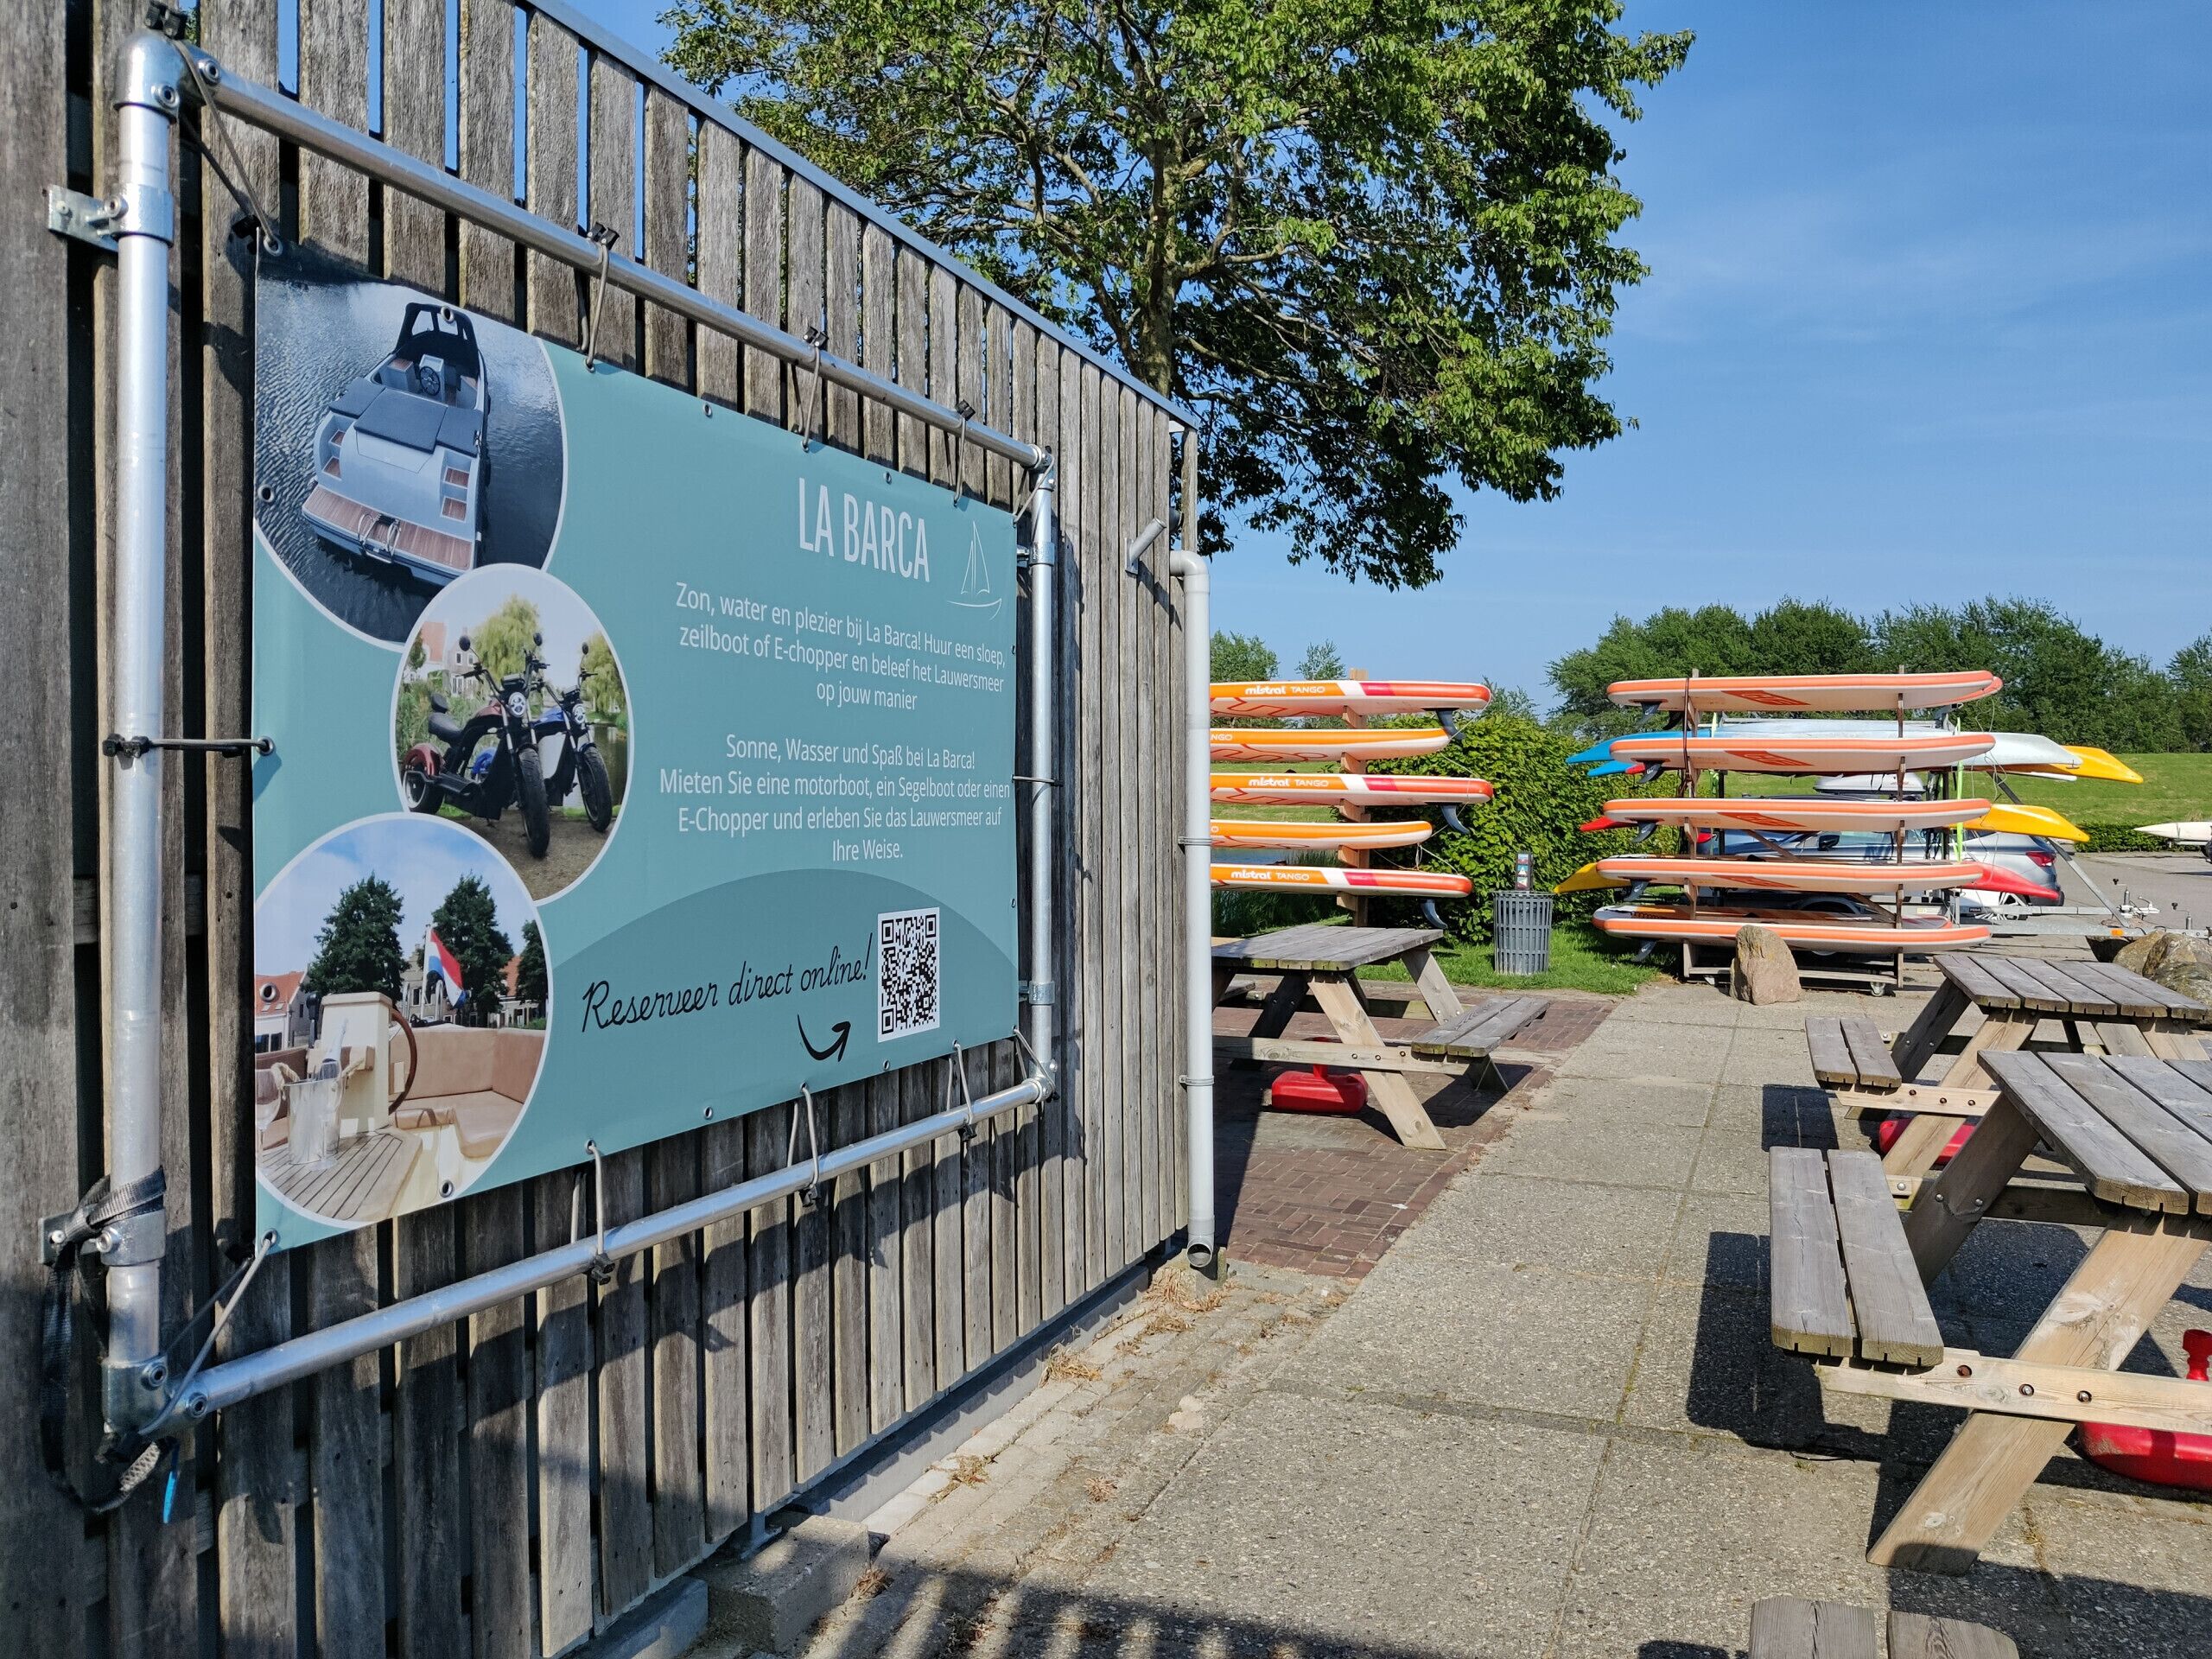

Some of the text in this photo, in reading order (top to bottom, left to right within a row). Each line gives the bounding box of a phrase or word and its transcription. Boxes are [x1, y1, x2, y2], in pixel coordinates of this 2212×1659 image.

[798, 477, 931, 582] LA BARCA
[676, 582, 1007, 669] Zon, water en plezier bij La Barca! Huur een sloep,
[679, 624, 1005, 693] zeilboot of E-chopper en beleef het Lauwersmeer
[817, 680, 918, 710] op jouw manier
[1245, 684, 1286, 695] mistral
[726, 734, 976, 772] Sonne, Wasser und Spaß bei La Barca!
[660, 768, 1010, 803] Mieten Sie eine motorboot, ein Segelboot oder einen
[1249, 777, 1289, 787] mistral
[678, 805, 1002, 838] E-Chopper und erleben Sie das Lauwersmeer auf
[832, 839, 904, 862] Ihre Weise.
[1231, 869, 1310, 880] mistral TANGO
[582, 931, 874, 1033] Reserveer direct online!
